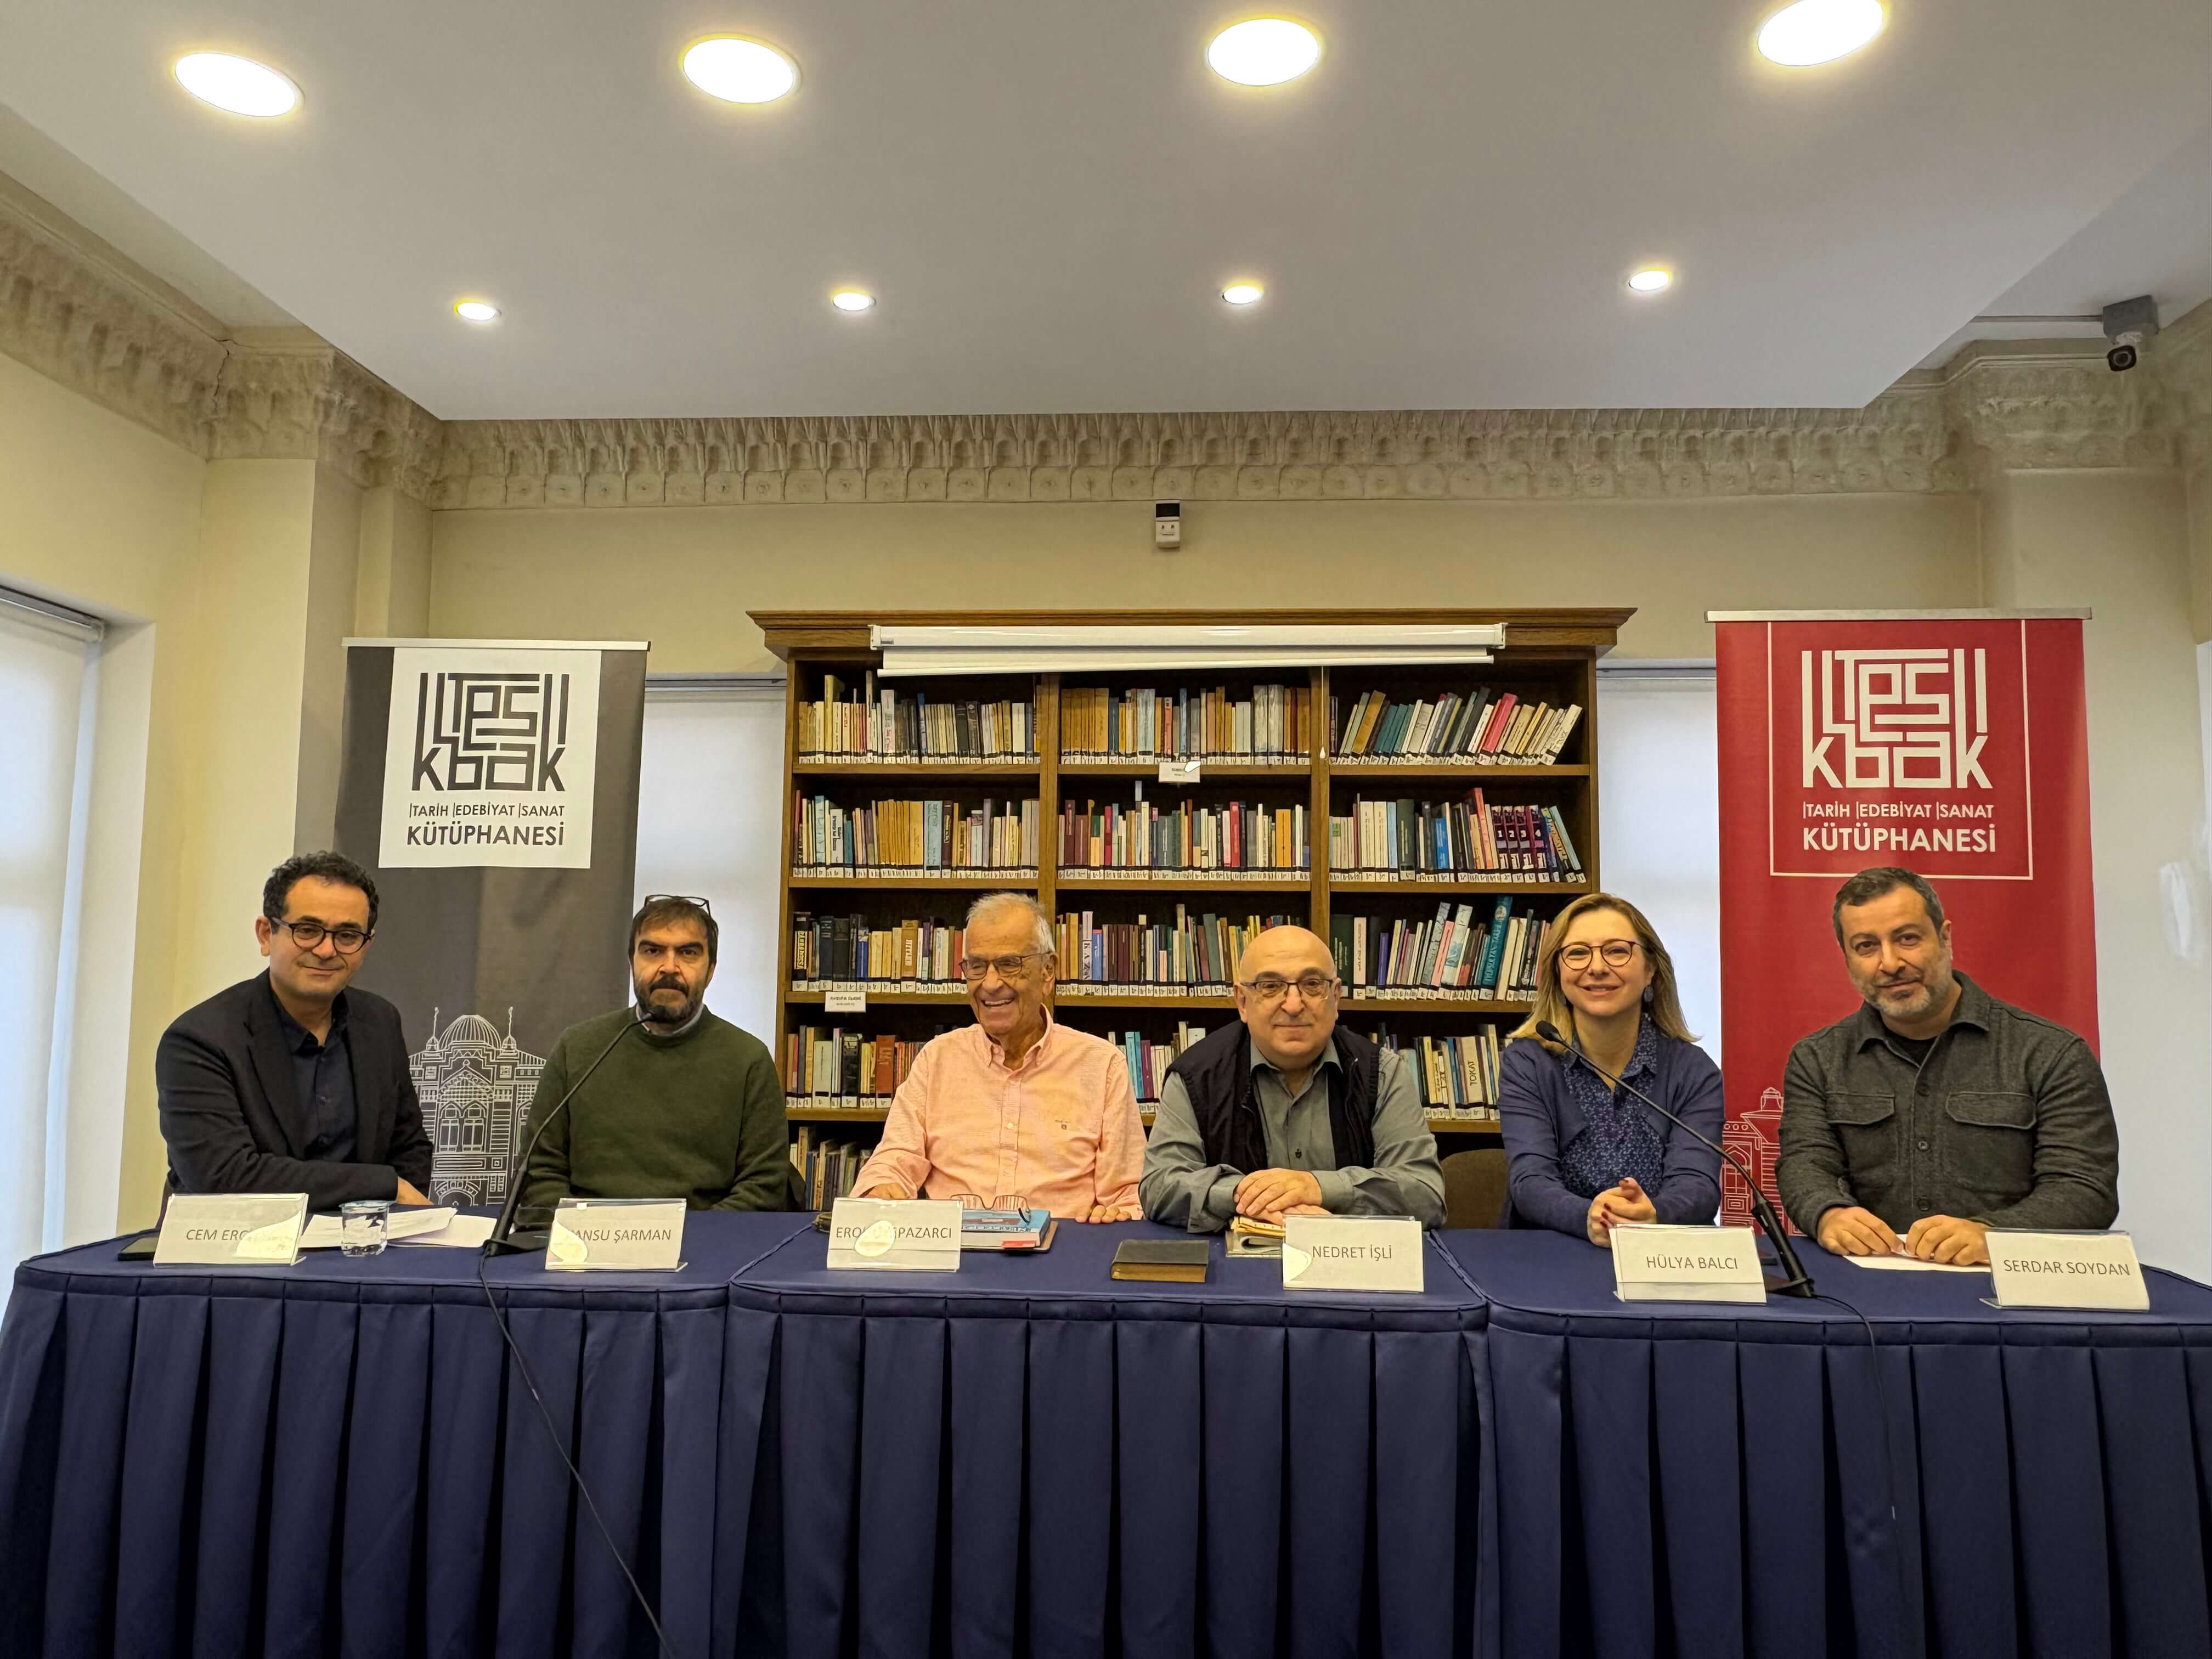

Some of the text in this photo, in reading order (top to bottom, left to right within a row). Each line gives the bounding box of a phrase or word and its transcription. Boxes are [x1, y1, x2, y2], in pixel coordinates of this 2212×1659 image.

[413, 802, 565, 817] TARİH EDEBİYAT SANAT
[1807, 800, 1994, 818] TARİH EDEBİYAT SANAT
[407, 821, 565, 845] KÜTÜPHANESİ
[1803, 822, 1996, 853] KÜTÜPHANESİ
[1468, 1060, 1478, 1086] TOKAT
[186, 1229, 217, 1240] CEM
[567, 1229, 672, 1243] ANSU ŞARMAN
[836, 1227, 869, 1238] ERO
[1312, 1244, 1392, 1261] NEDRET İŞLİ
[1646, 1254, 1738, 1270] HÜLYA BALCI
[2003, 1260, 2130, 1276] SERDAR SOYDAN
